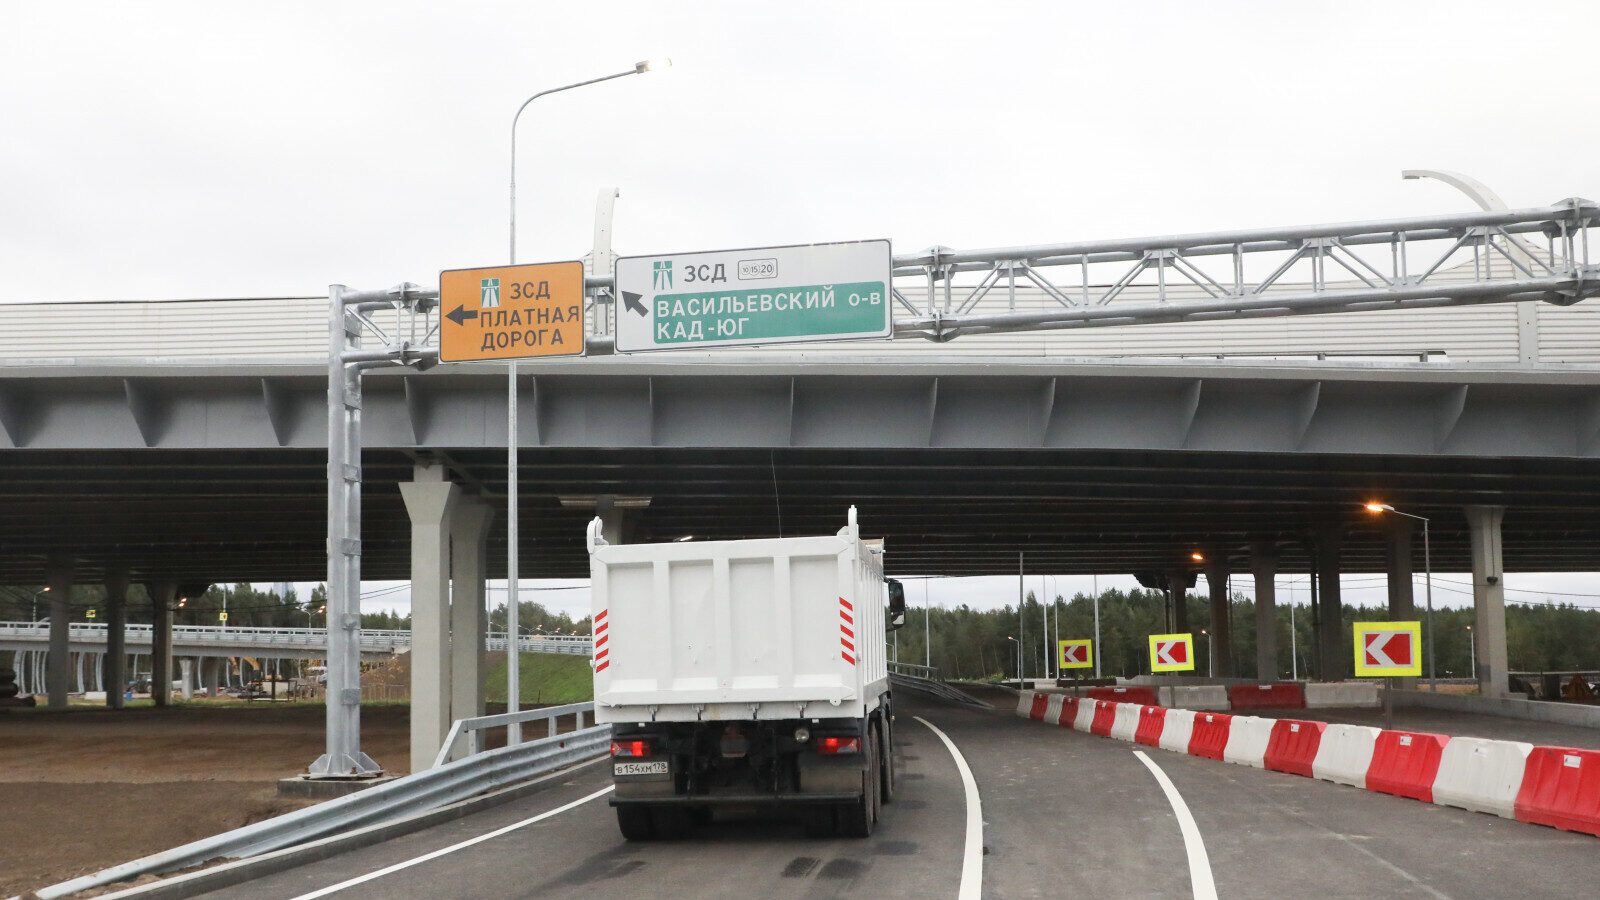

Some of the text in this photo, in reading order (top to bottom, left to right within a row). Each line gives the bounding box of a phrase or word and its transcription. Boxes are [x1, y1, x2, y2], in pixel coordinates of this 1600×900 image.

[683, 263, 727, 283] ЗСД
[761, 264, 773, 273] 20
[510, 281, 551, 300] ЗСД
[657, 285, 835, 318] ВАСИЛЬЕВСКИЙ
[480, 306, 580, 328] ПЛАТНАЯ
[480, 329, 564, 351] ДОРОГА
[657, 317, 750, 341] КАД-ЮГ
